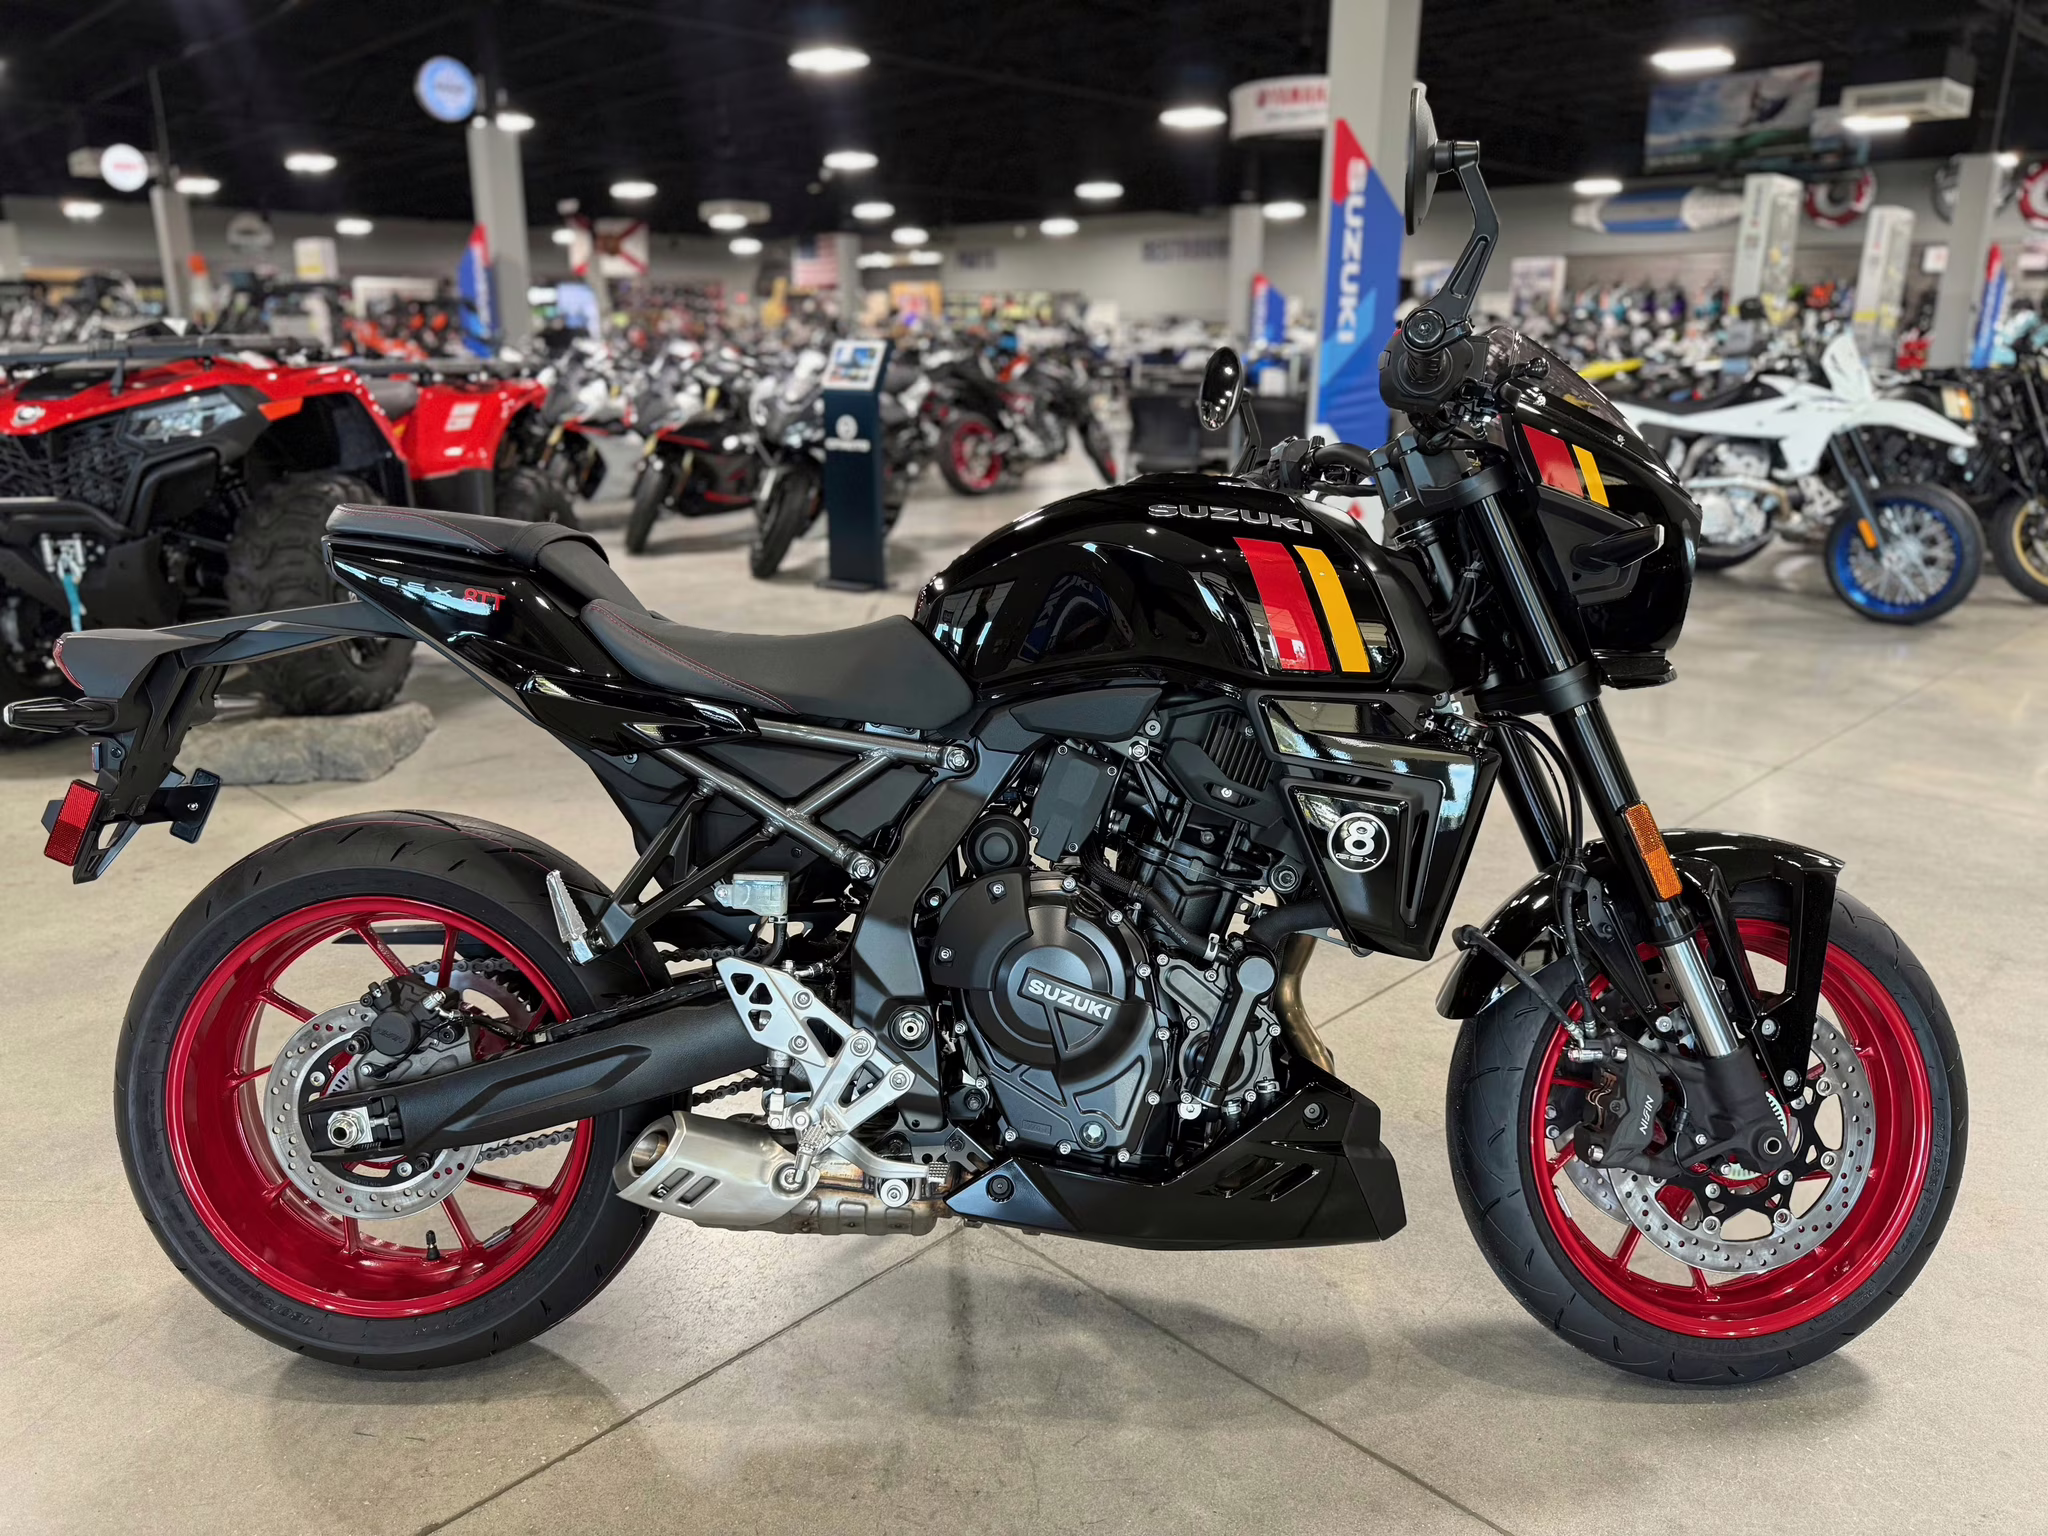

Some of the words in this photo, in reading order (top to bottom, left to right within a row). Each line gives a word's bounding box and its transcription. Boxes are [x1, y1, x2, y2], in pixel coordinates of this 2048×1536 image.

[1337, 157, 1368, 344] SUZUKI
[1148, 504, 1313, 534] SUZUKI
[1344, 820, 1376, 856] 8
[1335, 852, 1377, 864] GSX
[1028, 979, 1112, 1020] SUZUKI
